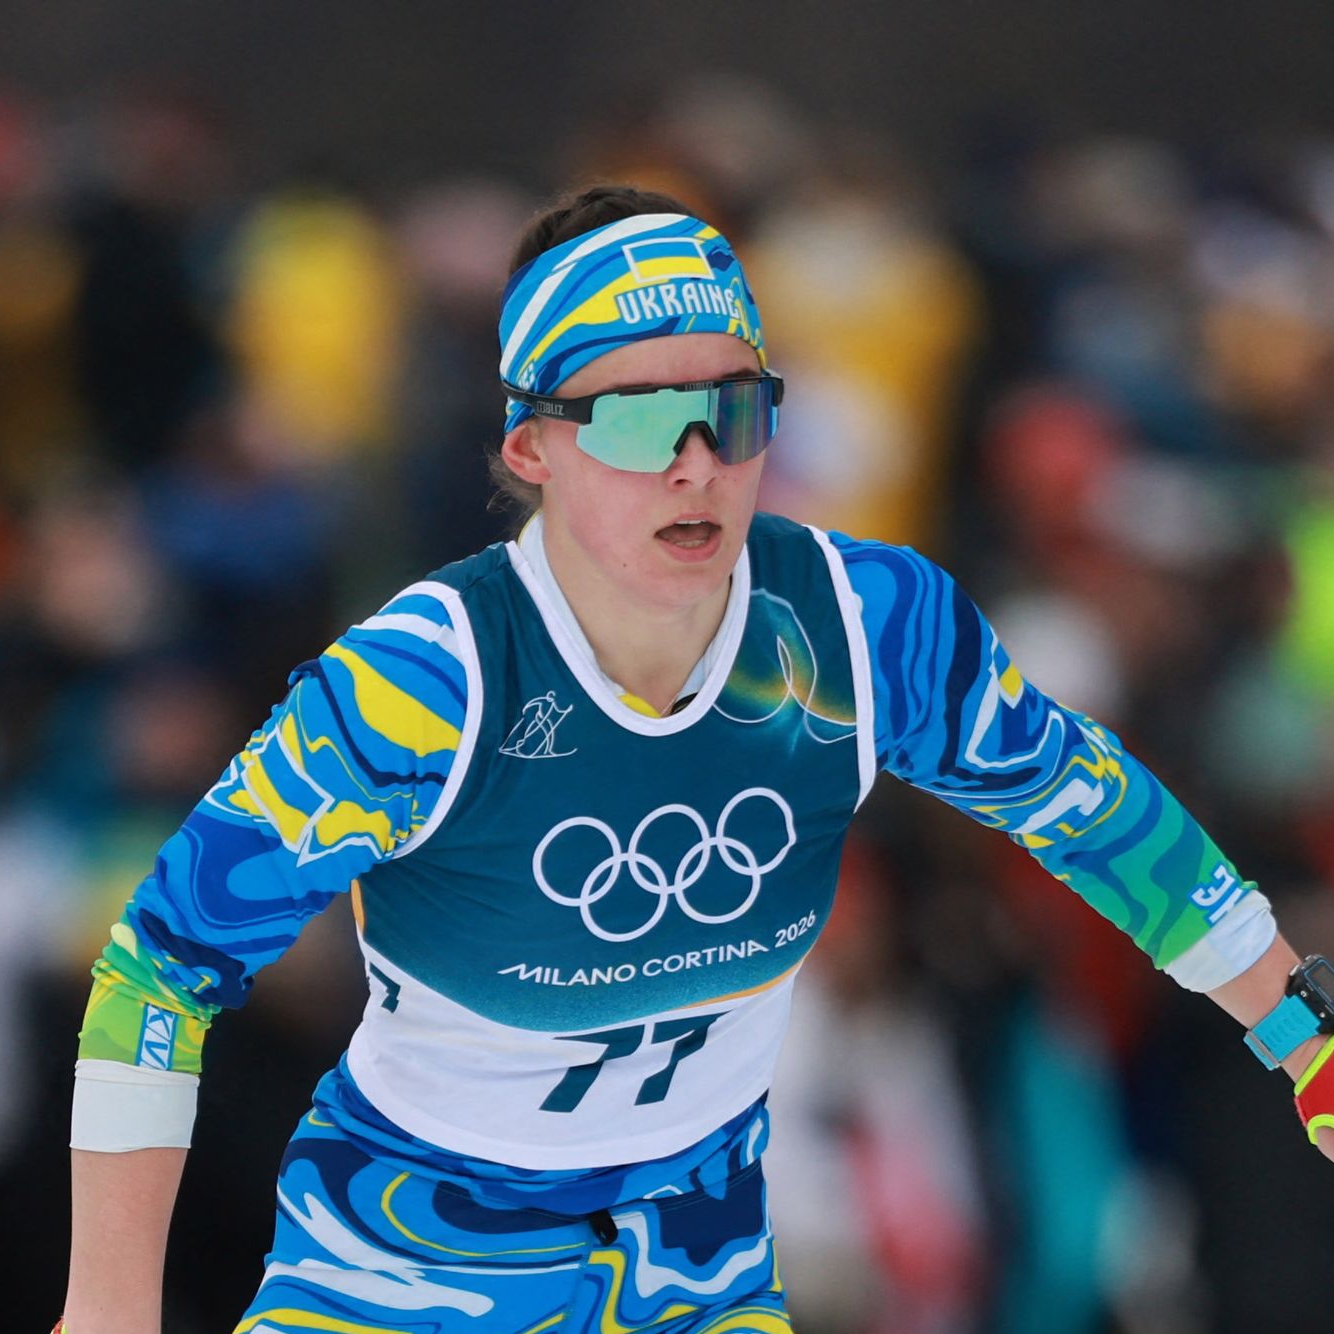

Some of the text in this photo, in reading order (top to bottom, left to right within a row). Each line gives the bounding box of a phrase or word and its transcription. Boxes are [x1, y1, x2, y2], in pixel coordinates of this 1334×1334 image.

[618, 282, 741, 324] UKRAINE
[498, 909, 818, 986] MILANO CORTINA 2026
[538, 1010, 735, 1114] 77
